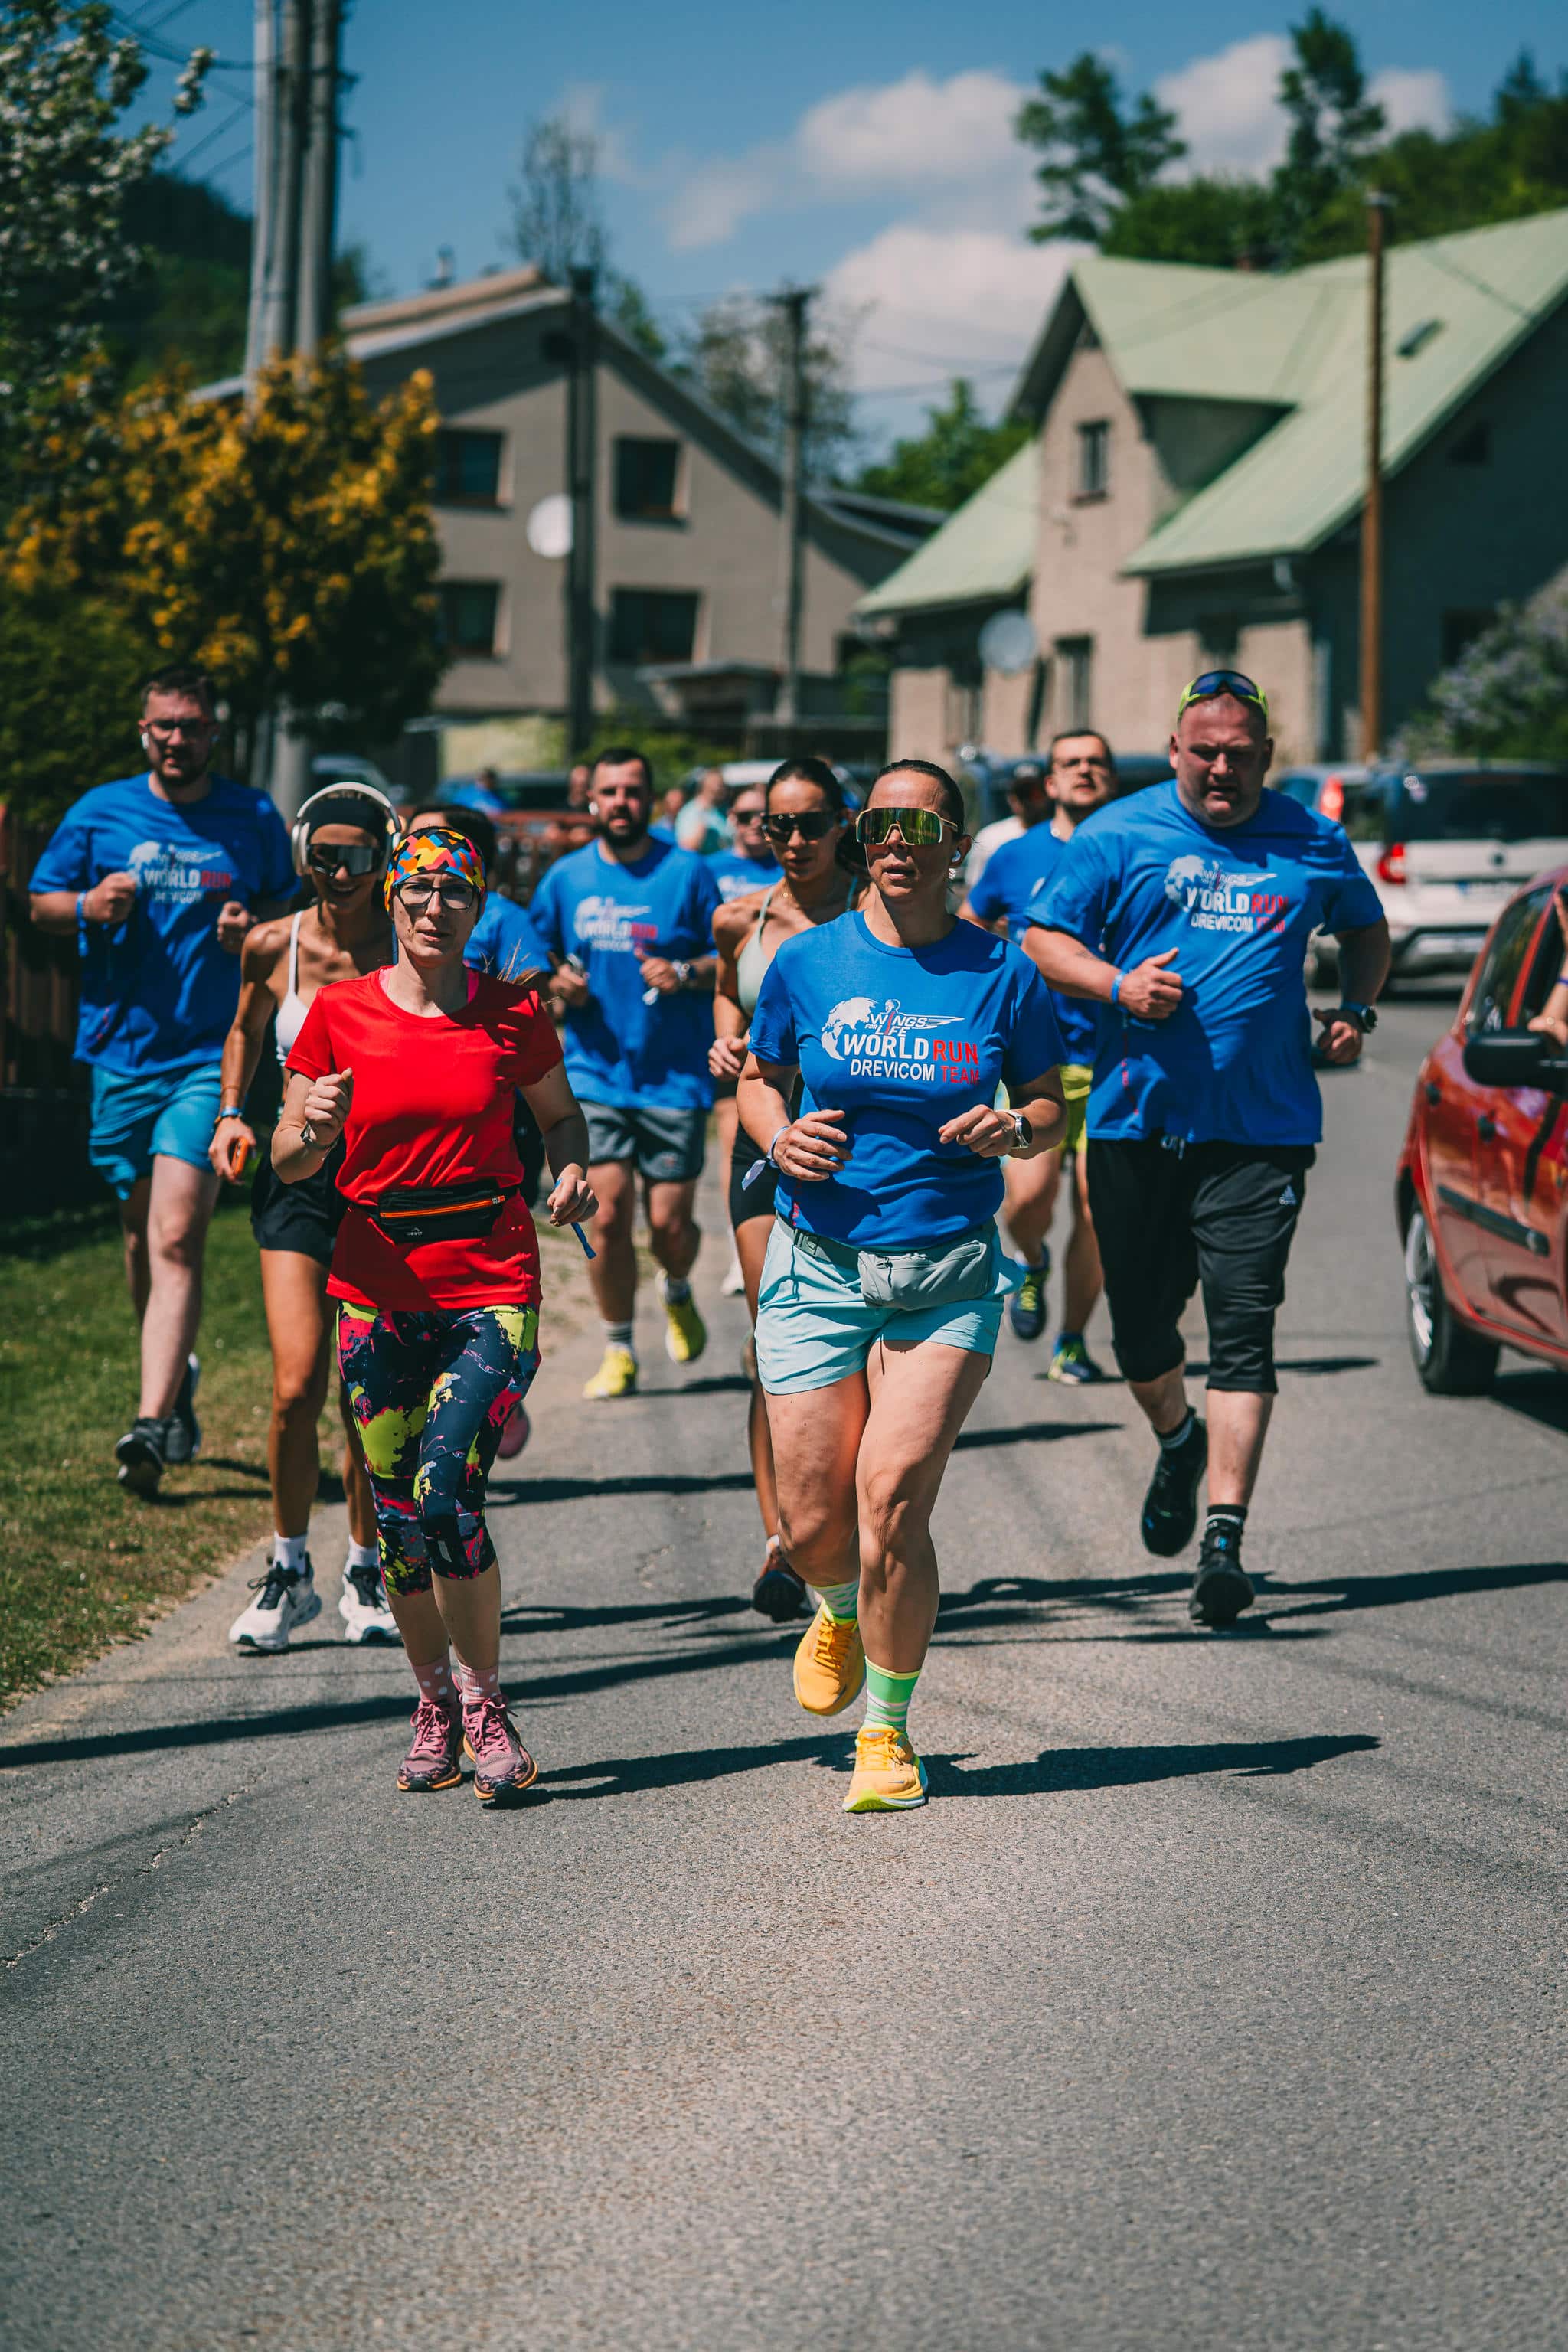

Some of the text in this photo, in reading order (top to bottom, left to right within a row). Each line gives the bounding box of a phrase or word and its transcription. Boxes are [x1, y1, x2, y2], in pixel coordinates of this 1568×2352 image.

[144, 869, 232, 888] WORLD RUN
[1251, 893, 1289, 915] RUN
[869, 1012, 929, 1028] WINGS
[875, 1025, 913, 1037] LIFE
[844, 1034, 979, 1065] WORLD RUN
[850, 1059, 981, 1085] DREVICOM TEAM
